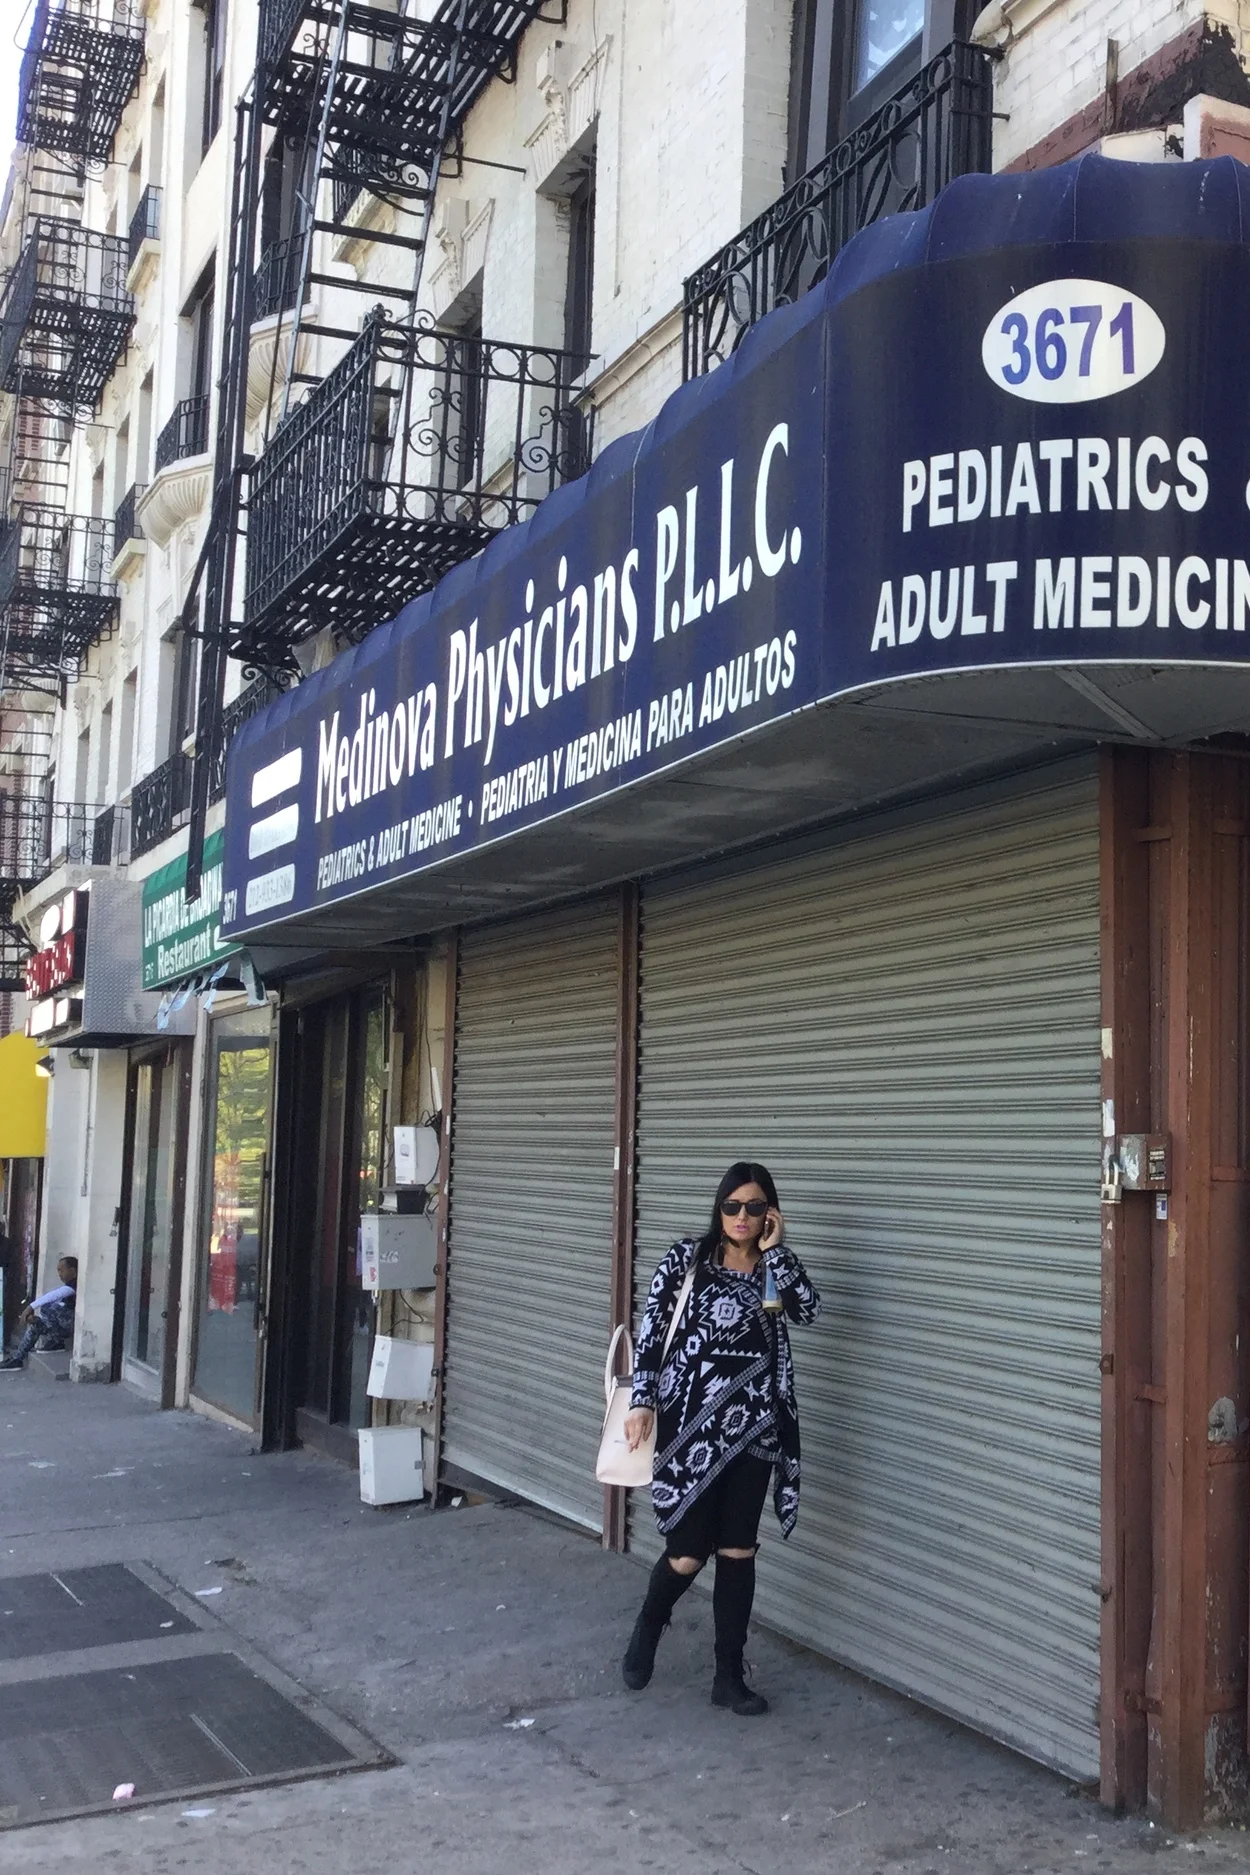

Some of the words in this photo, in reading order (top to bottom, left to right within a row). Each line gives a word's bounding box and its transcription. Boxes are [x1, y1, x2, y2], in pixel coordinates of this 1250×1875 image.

[1001, 302, 1135, 385] 3671
[903, 436, 1208, 532] PEDIATRICS
[315, 683, 436, 823] Medinova
[444, 549, 638, 765] Physicians
[654, 422, 801, 642] P.L.L.C.
[871, 561, 1017, 651] ADULT
[317, 839, 367, 891] PEDIATRICS
[367, 835, 375, 872] &
[376, 820, 409, 868] ADULT
[409, 794, 463, 855] MEDICINE
[480, 754, 549, 825] PEDIATRIA
[552, 747, 563, 794] Y
[564, 709, 642, 789] MEDICINA
[647, 682, 693, 752] PARA
[699, 630, 796, 727] ADULTOS
[157, 922, 211, 980] Restaurant
